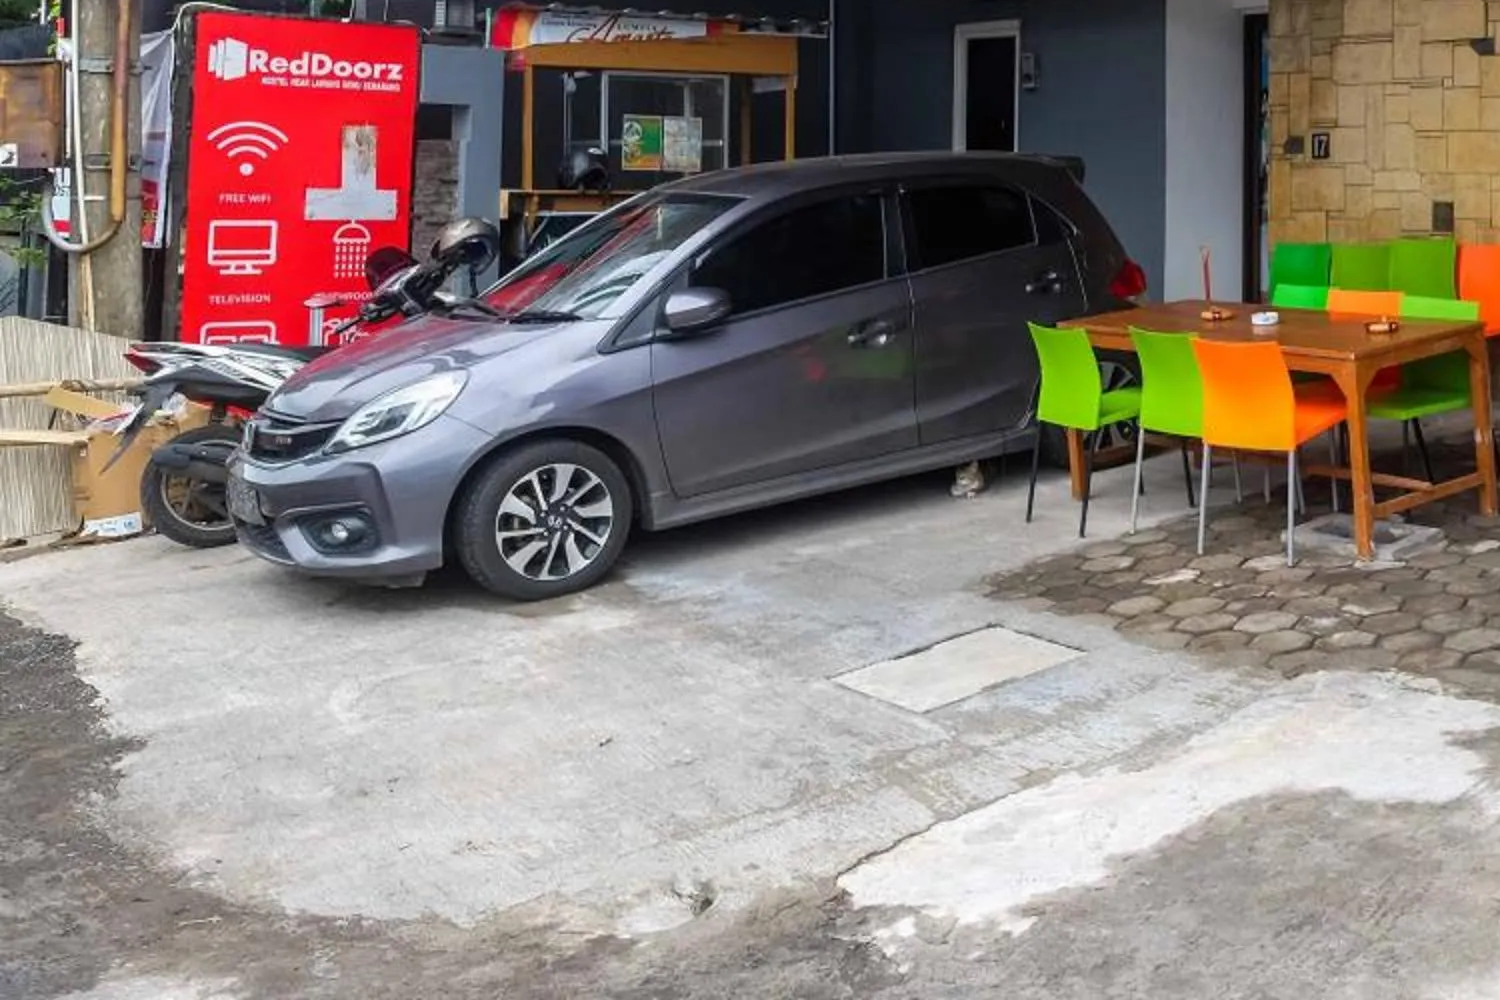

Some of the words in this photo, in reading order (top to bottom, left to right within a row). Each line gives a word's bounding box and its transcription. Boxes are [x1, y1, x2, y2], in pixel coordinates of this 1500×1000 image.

[250, 49, 403, 81] RedDoorz
[1313, 135, 1328, 157] 17
[218, 193, 245, 204] FREE
[208, 294, 271, 305] TELEVISION
